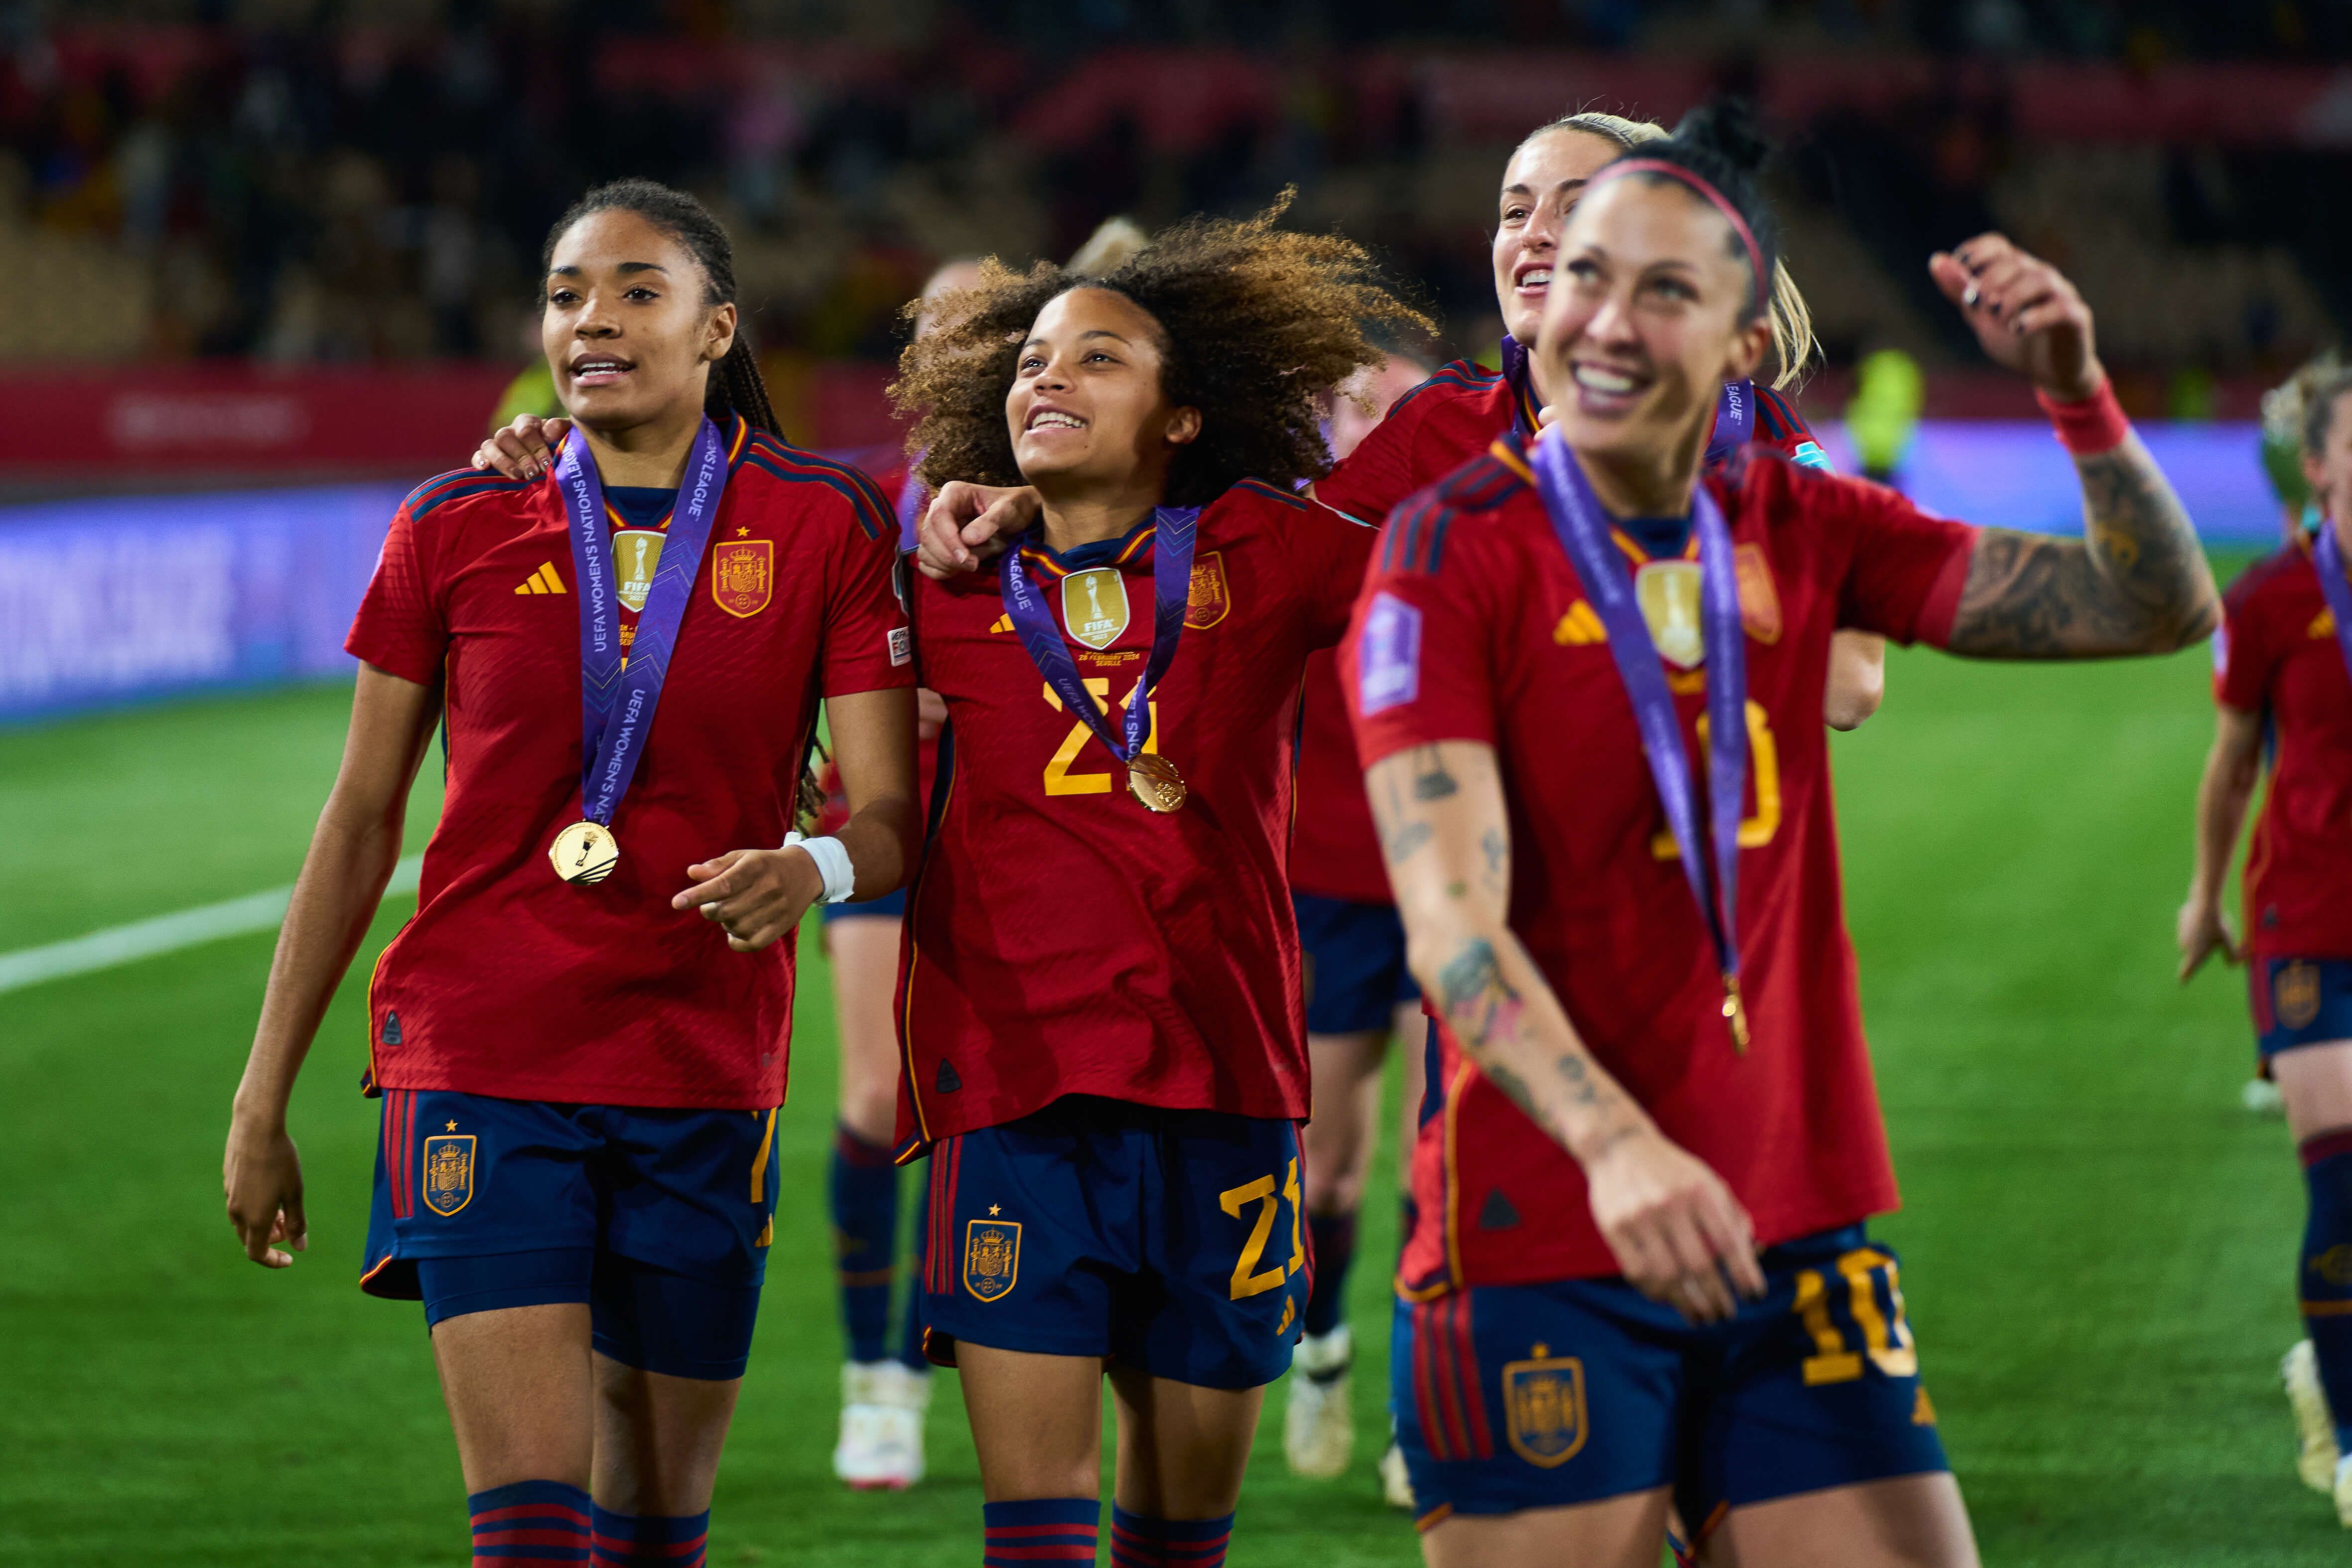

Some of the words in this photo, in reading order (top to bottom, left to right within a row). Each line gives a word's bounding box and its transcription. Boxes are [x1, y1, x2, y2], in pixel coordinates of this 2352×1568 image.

[1724, 382, 1742, 422] LEAGUE
[573, 479, 596, 543] NATIONS
[688, 463, 715, 517] LEAGUE
[585, 545, 605, 614] WOMEN'S
[1010, 559, 1033, 610] LEAGUE
[594, 614, 607, 652] UEFA
[1084, 619, 1113, 632] FIFA
[623, 689, 646, 723] UEFA
[601, 727, 635, 793] WOMEN'S
[1219, 1156, 1305, 1301] 21
[1791, 1247, 1918, 1388] 10
